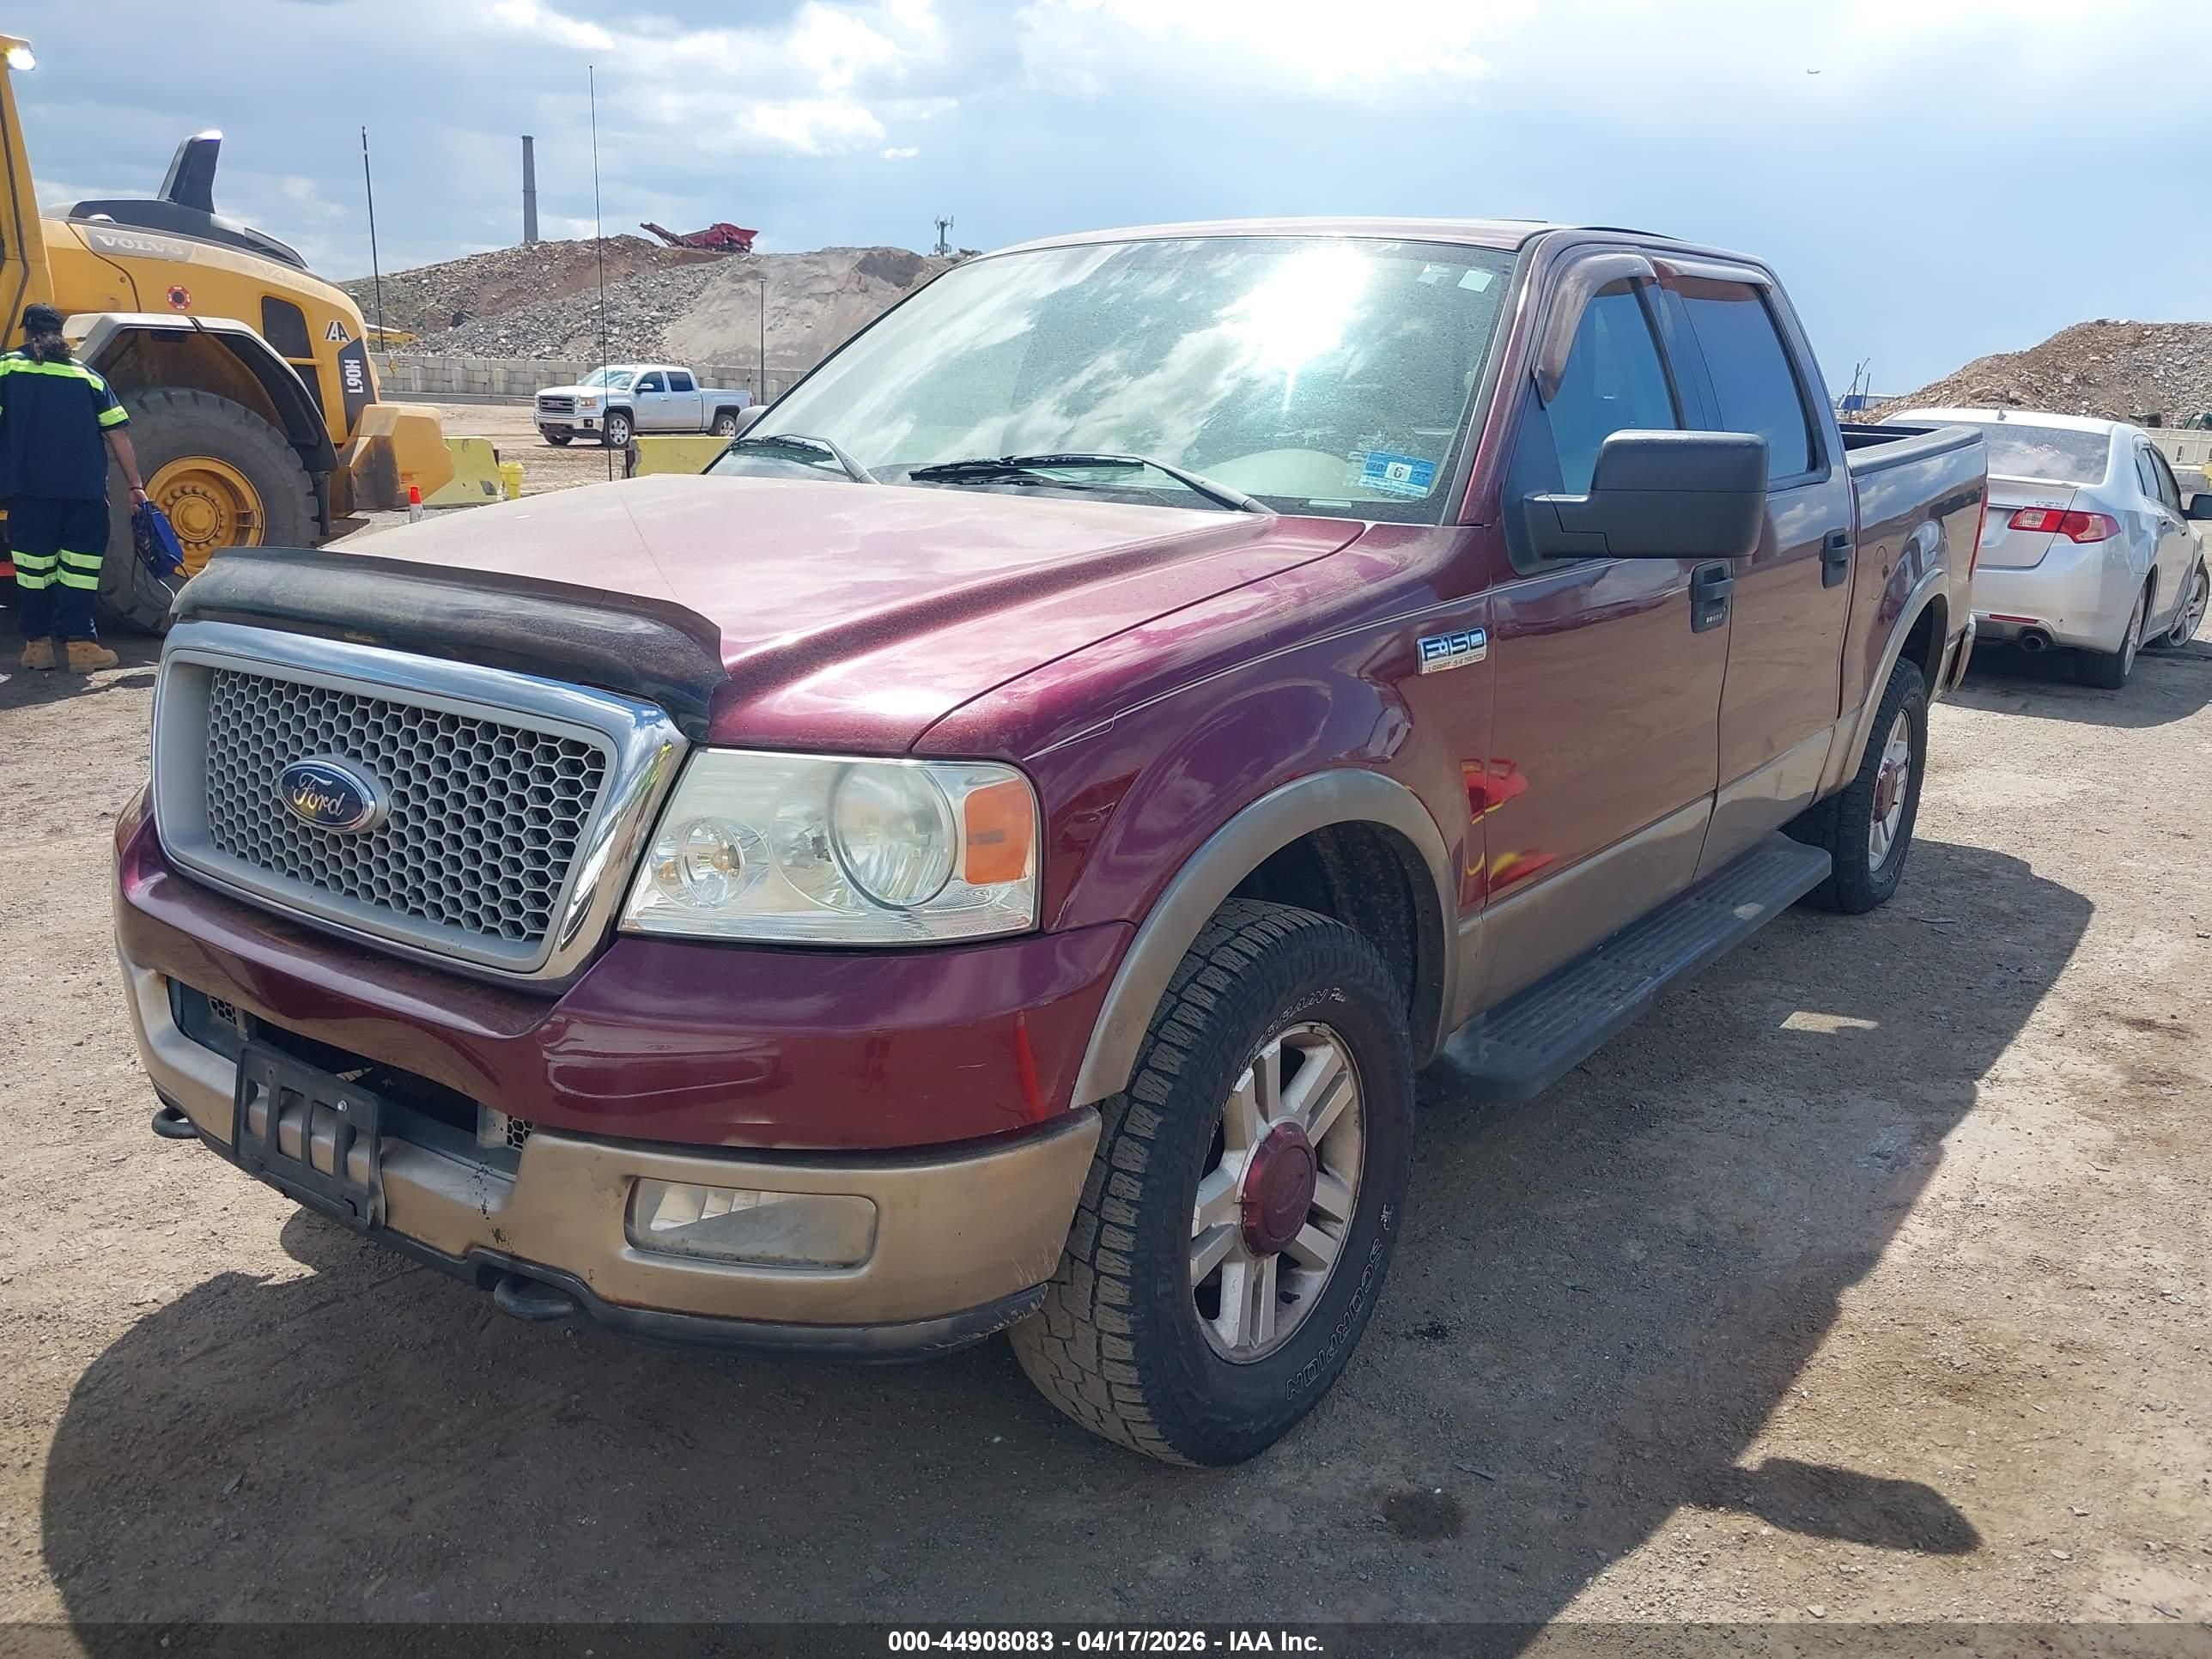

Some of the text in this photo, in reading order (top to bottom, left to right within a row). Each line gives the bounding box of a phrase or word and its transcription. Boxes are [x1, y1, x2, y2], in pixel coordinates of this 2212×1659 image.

[94, 234, 185, 255] VOLVO
[343, 359, 364, 393] L90H
[1393, 466, 1404, 478] 6
[293, 772, 346, 817] Ford
[1286, 1237, 1383, 1401] SCORPION
